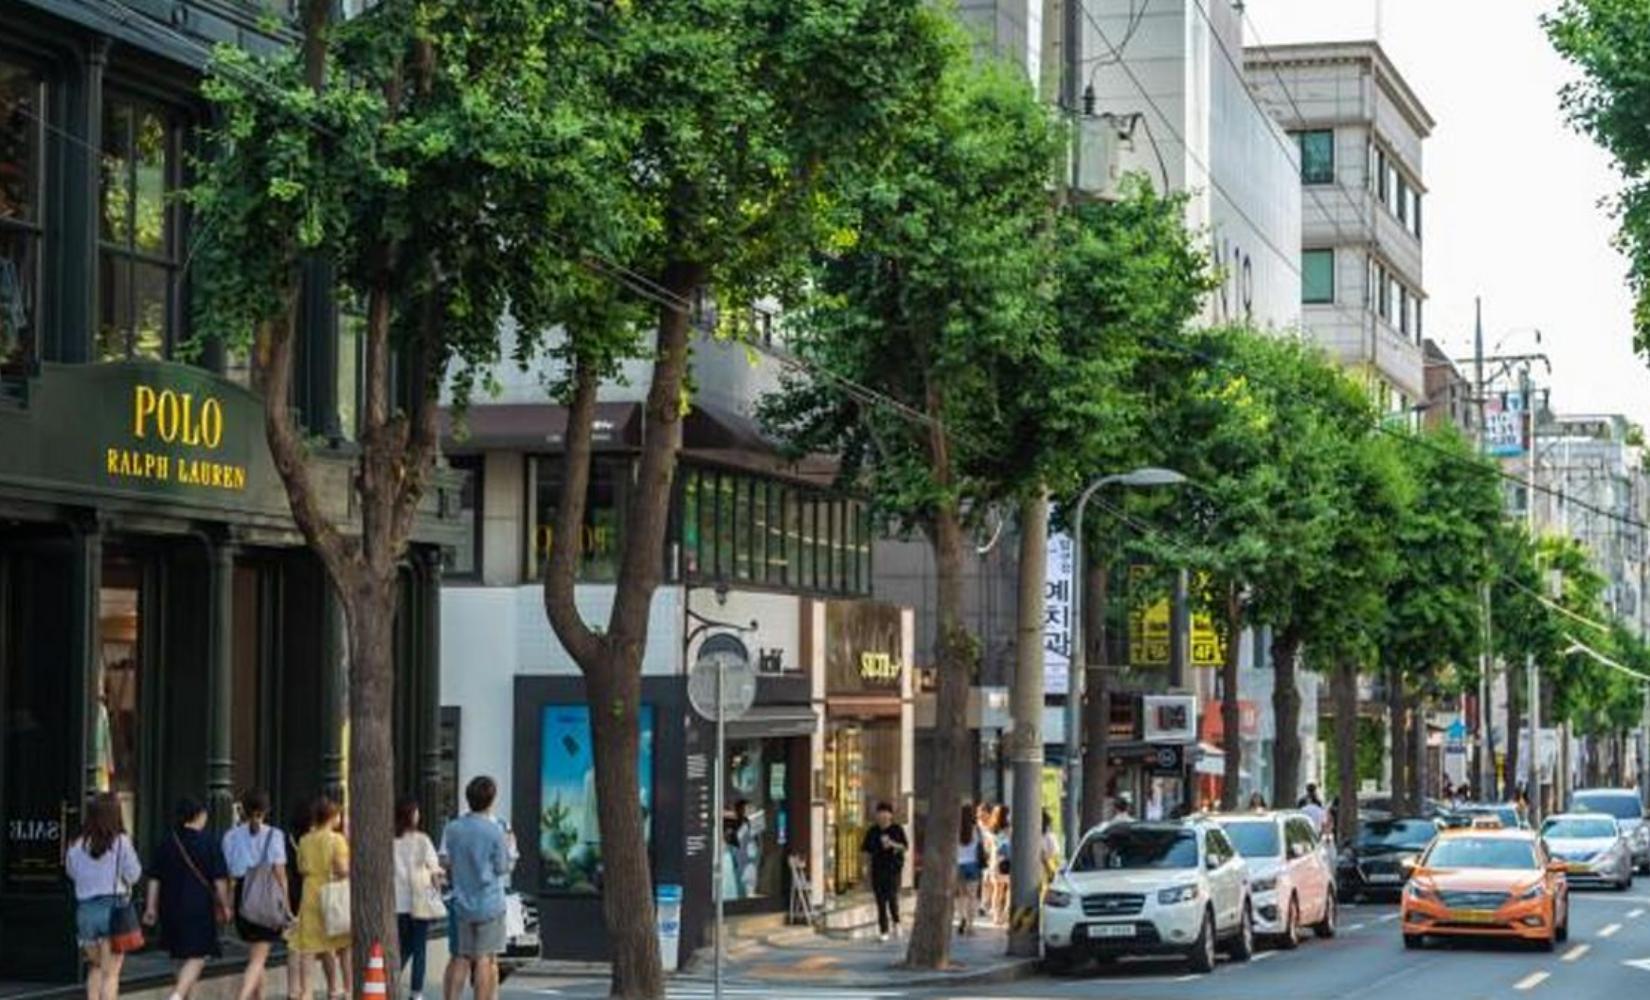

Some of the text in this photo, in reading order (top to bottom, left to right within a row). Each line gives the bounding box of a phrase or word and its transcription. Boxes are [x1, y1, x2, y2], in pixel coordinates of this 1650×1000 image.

[134, 385, 222, 448] POLO
[107, 448, 246, 489] RALPH LAUREN
[1044, 580, 1070, 657] 예치과
